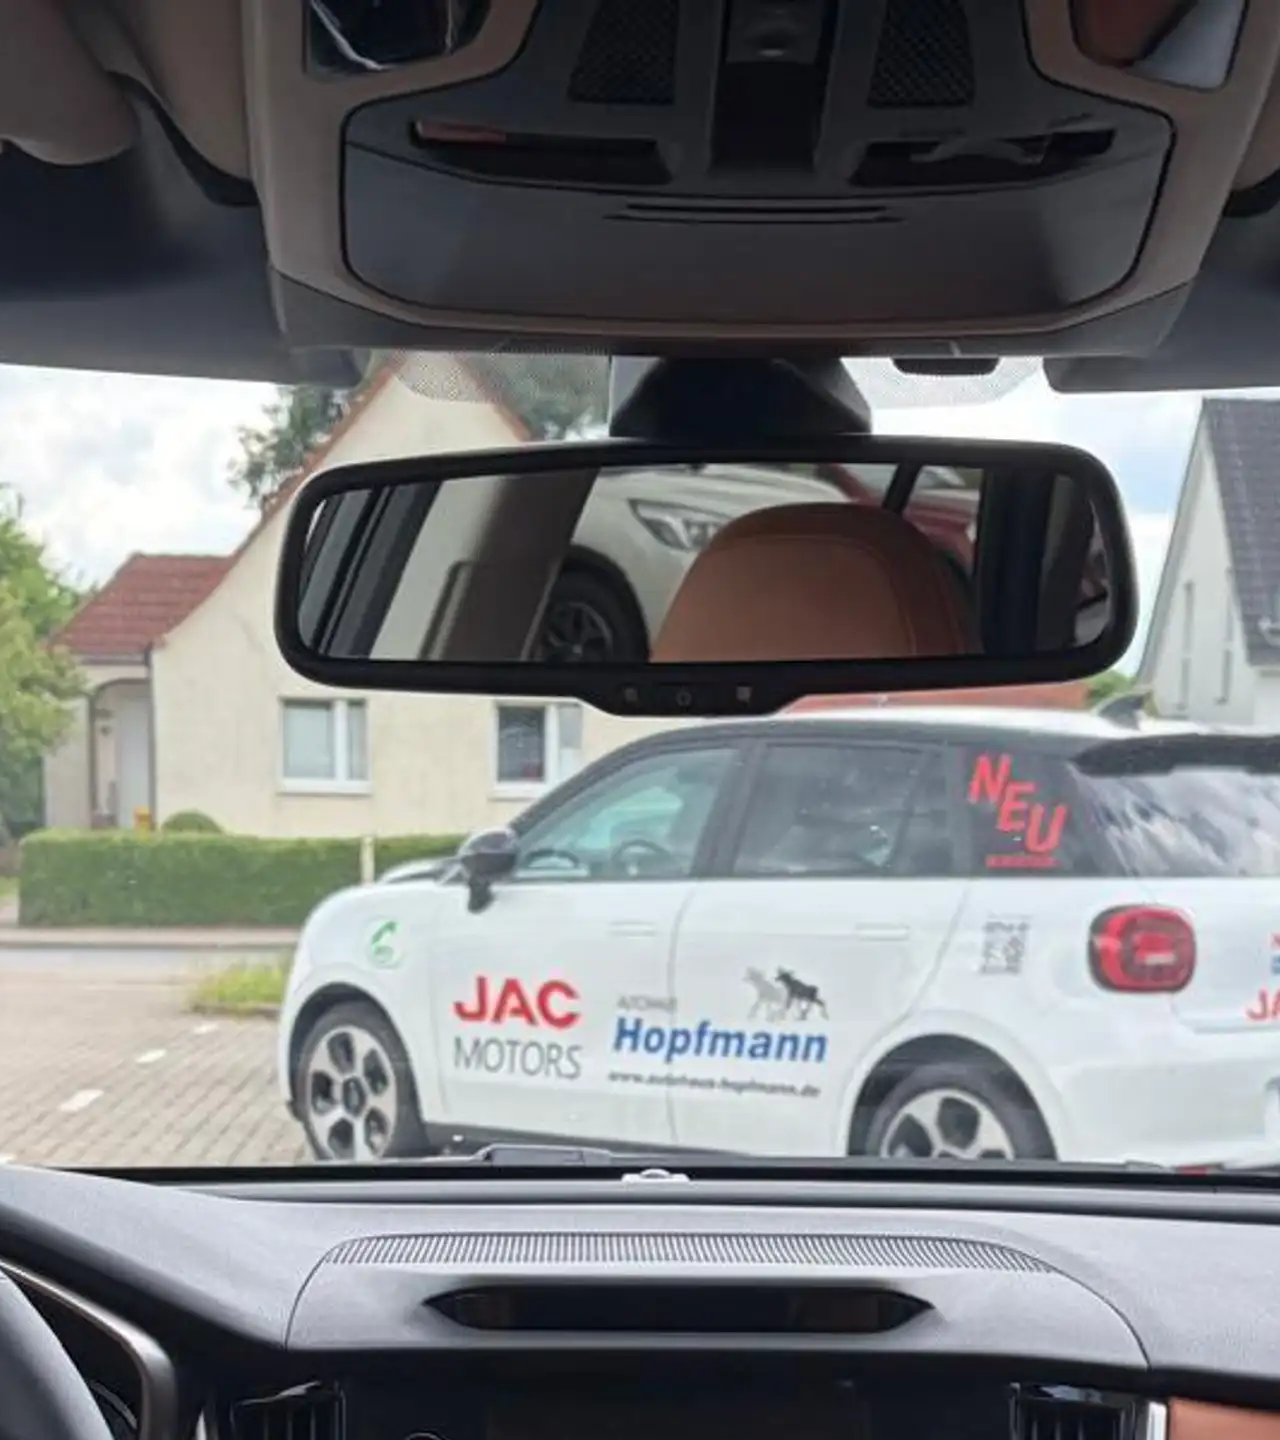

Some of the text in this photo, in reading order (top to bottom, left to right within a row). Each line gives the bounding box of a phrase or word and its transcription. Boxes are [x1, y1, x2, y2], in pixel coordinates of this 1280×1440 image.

[968, 753, 1068, 854] NEU
[453, 976, 579, 1029] JAC
[453, 1036, 582, 1080] MOTORS
[613, 1016, 828, 1065] Hopfmann
